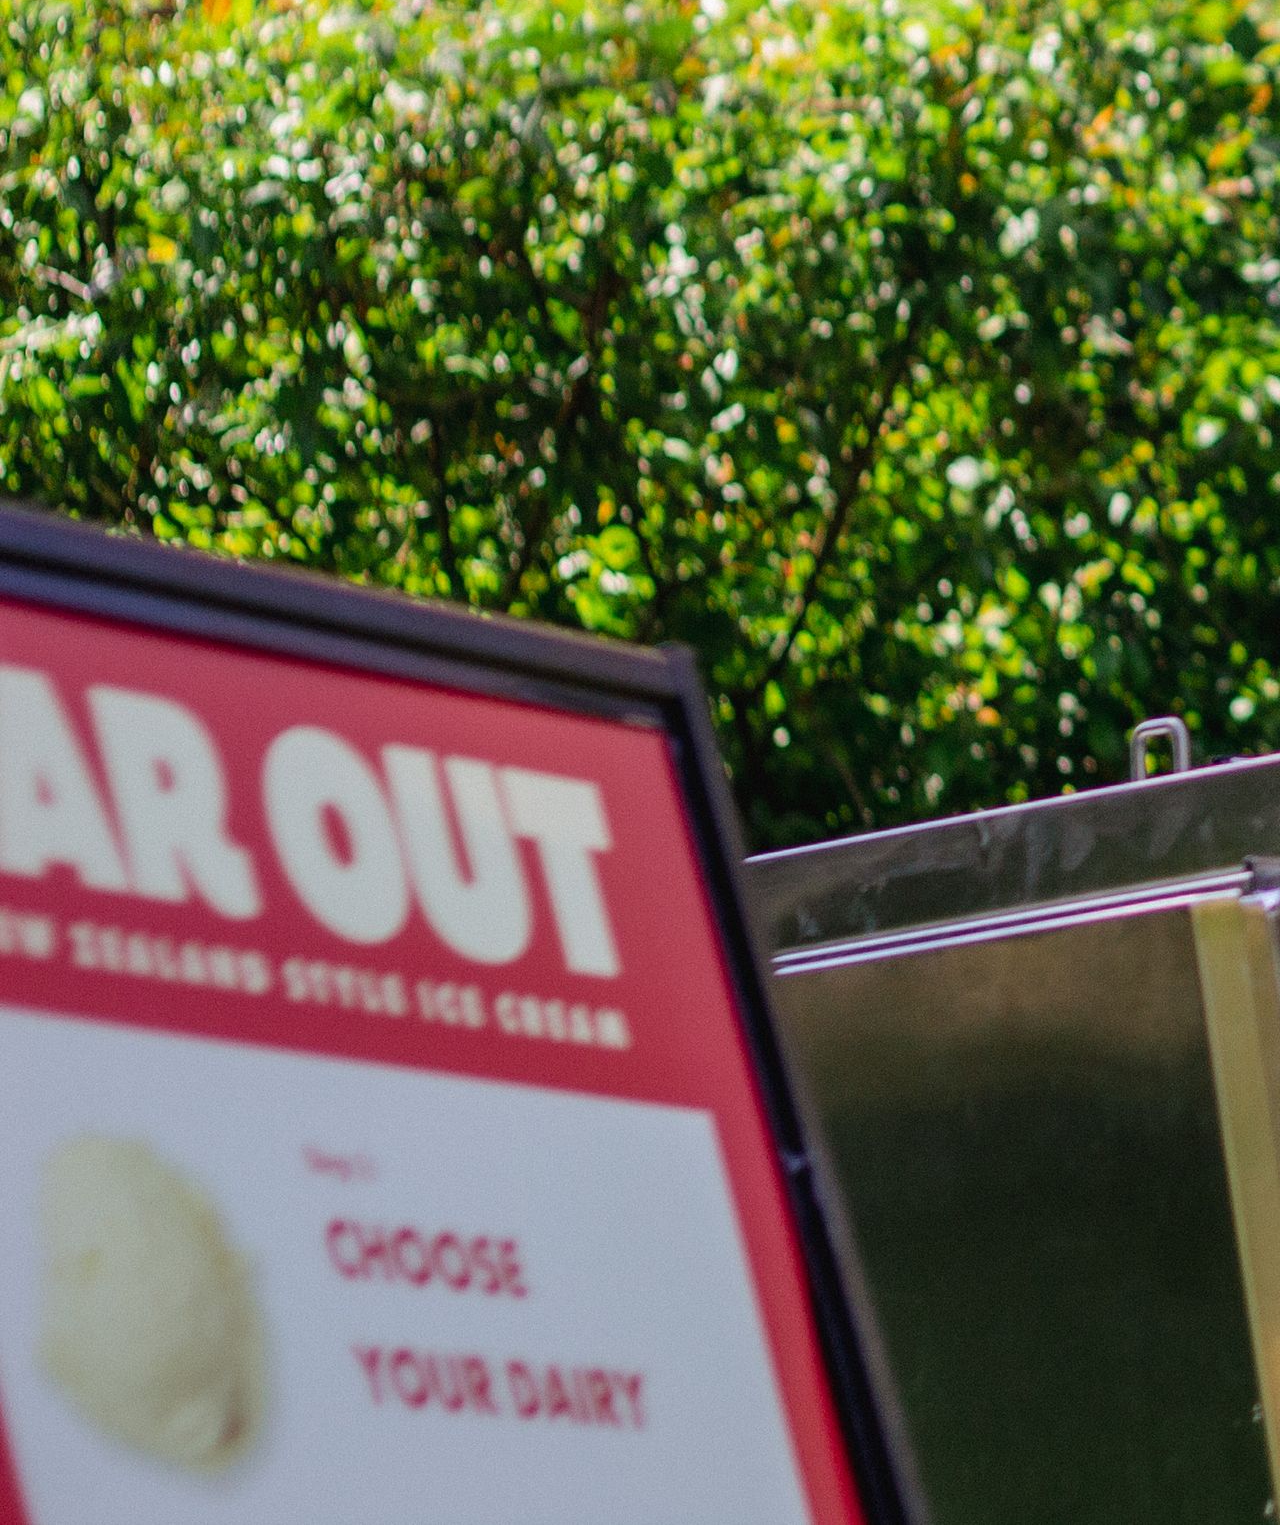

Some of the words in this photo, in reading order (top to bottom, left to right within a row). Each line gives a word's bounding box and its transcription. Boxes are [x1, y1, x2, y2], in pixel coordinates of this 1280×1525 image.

[0, 668, 262, 921] AR
[262, 725, 622, 978] OUT
[0, 908, 56, 959] EW
[417, 979, 487, 1029] ICE
[325, 1216, 530, 1299] CHOOSE
[350, 1344, 501, 1416] YOUR
[505, 1358, 646, 1431] DAIRY
